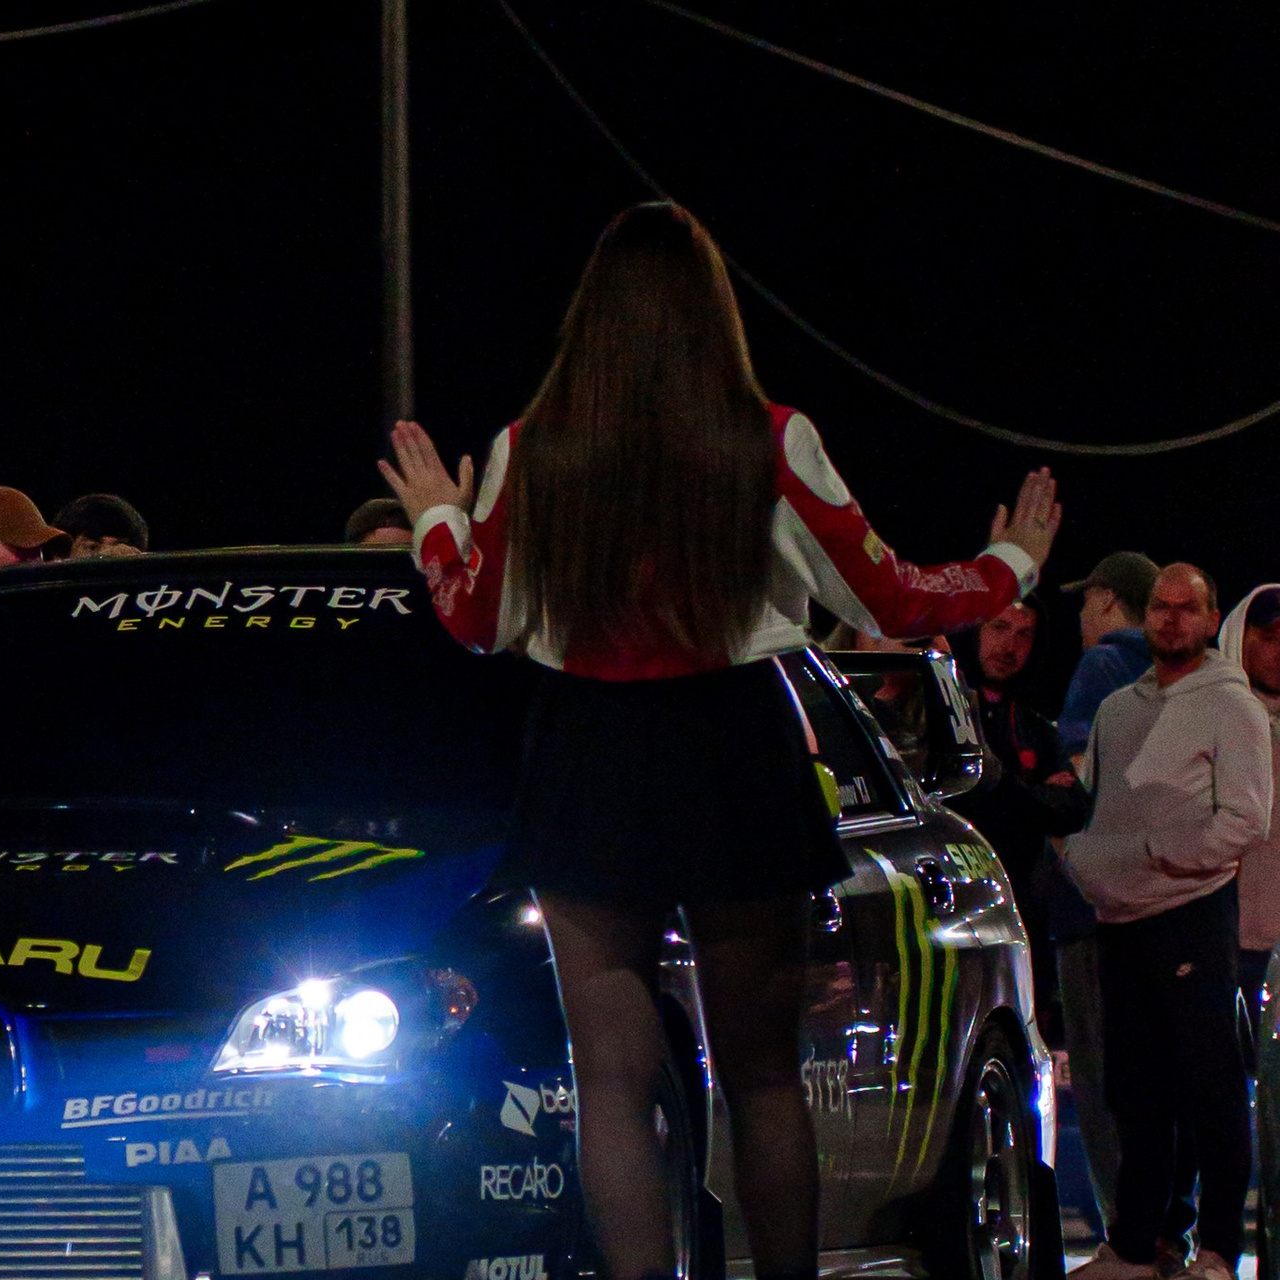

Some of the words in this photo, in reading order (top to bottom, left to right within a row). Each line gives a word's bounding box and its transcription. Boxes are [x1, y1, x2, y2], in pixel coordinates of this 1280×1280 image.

[116, 616, 361, 631] ENERGY
[62, 1087, 272, 1120] BFGoodrich
[125, 1136, 232, 1167] PIAA
[294, 1160, 384, 1208] 988
[480, 1156, 565, 1200] RECARO
[335, 1214, 402, 1252] 138
